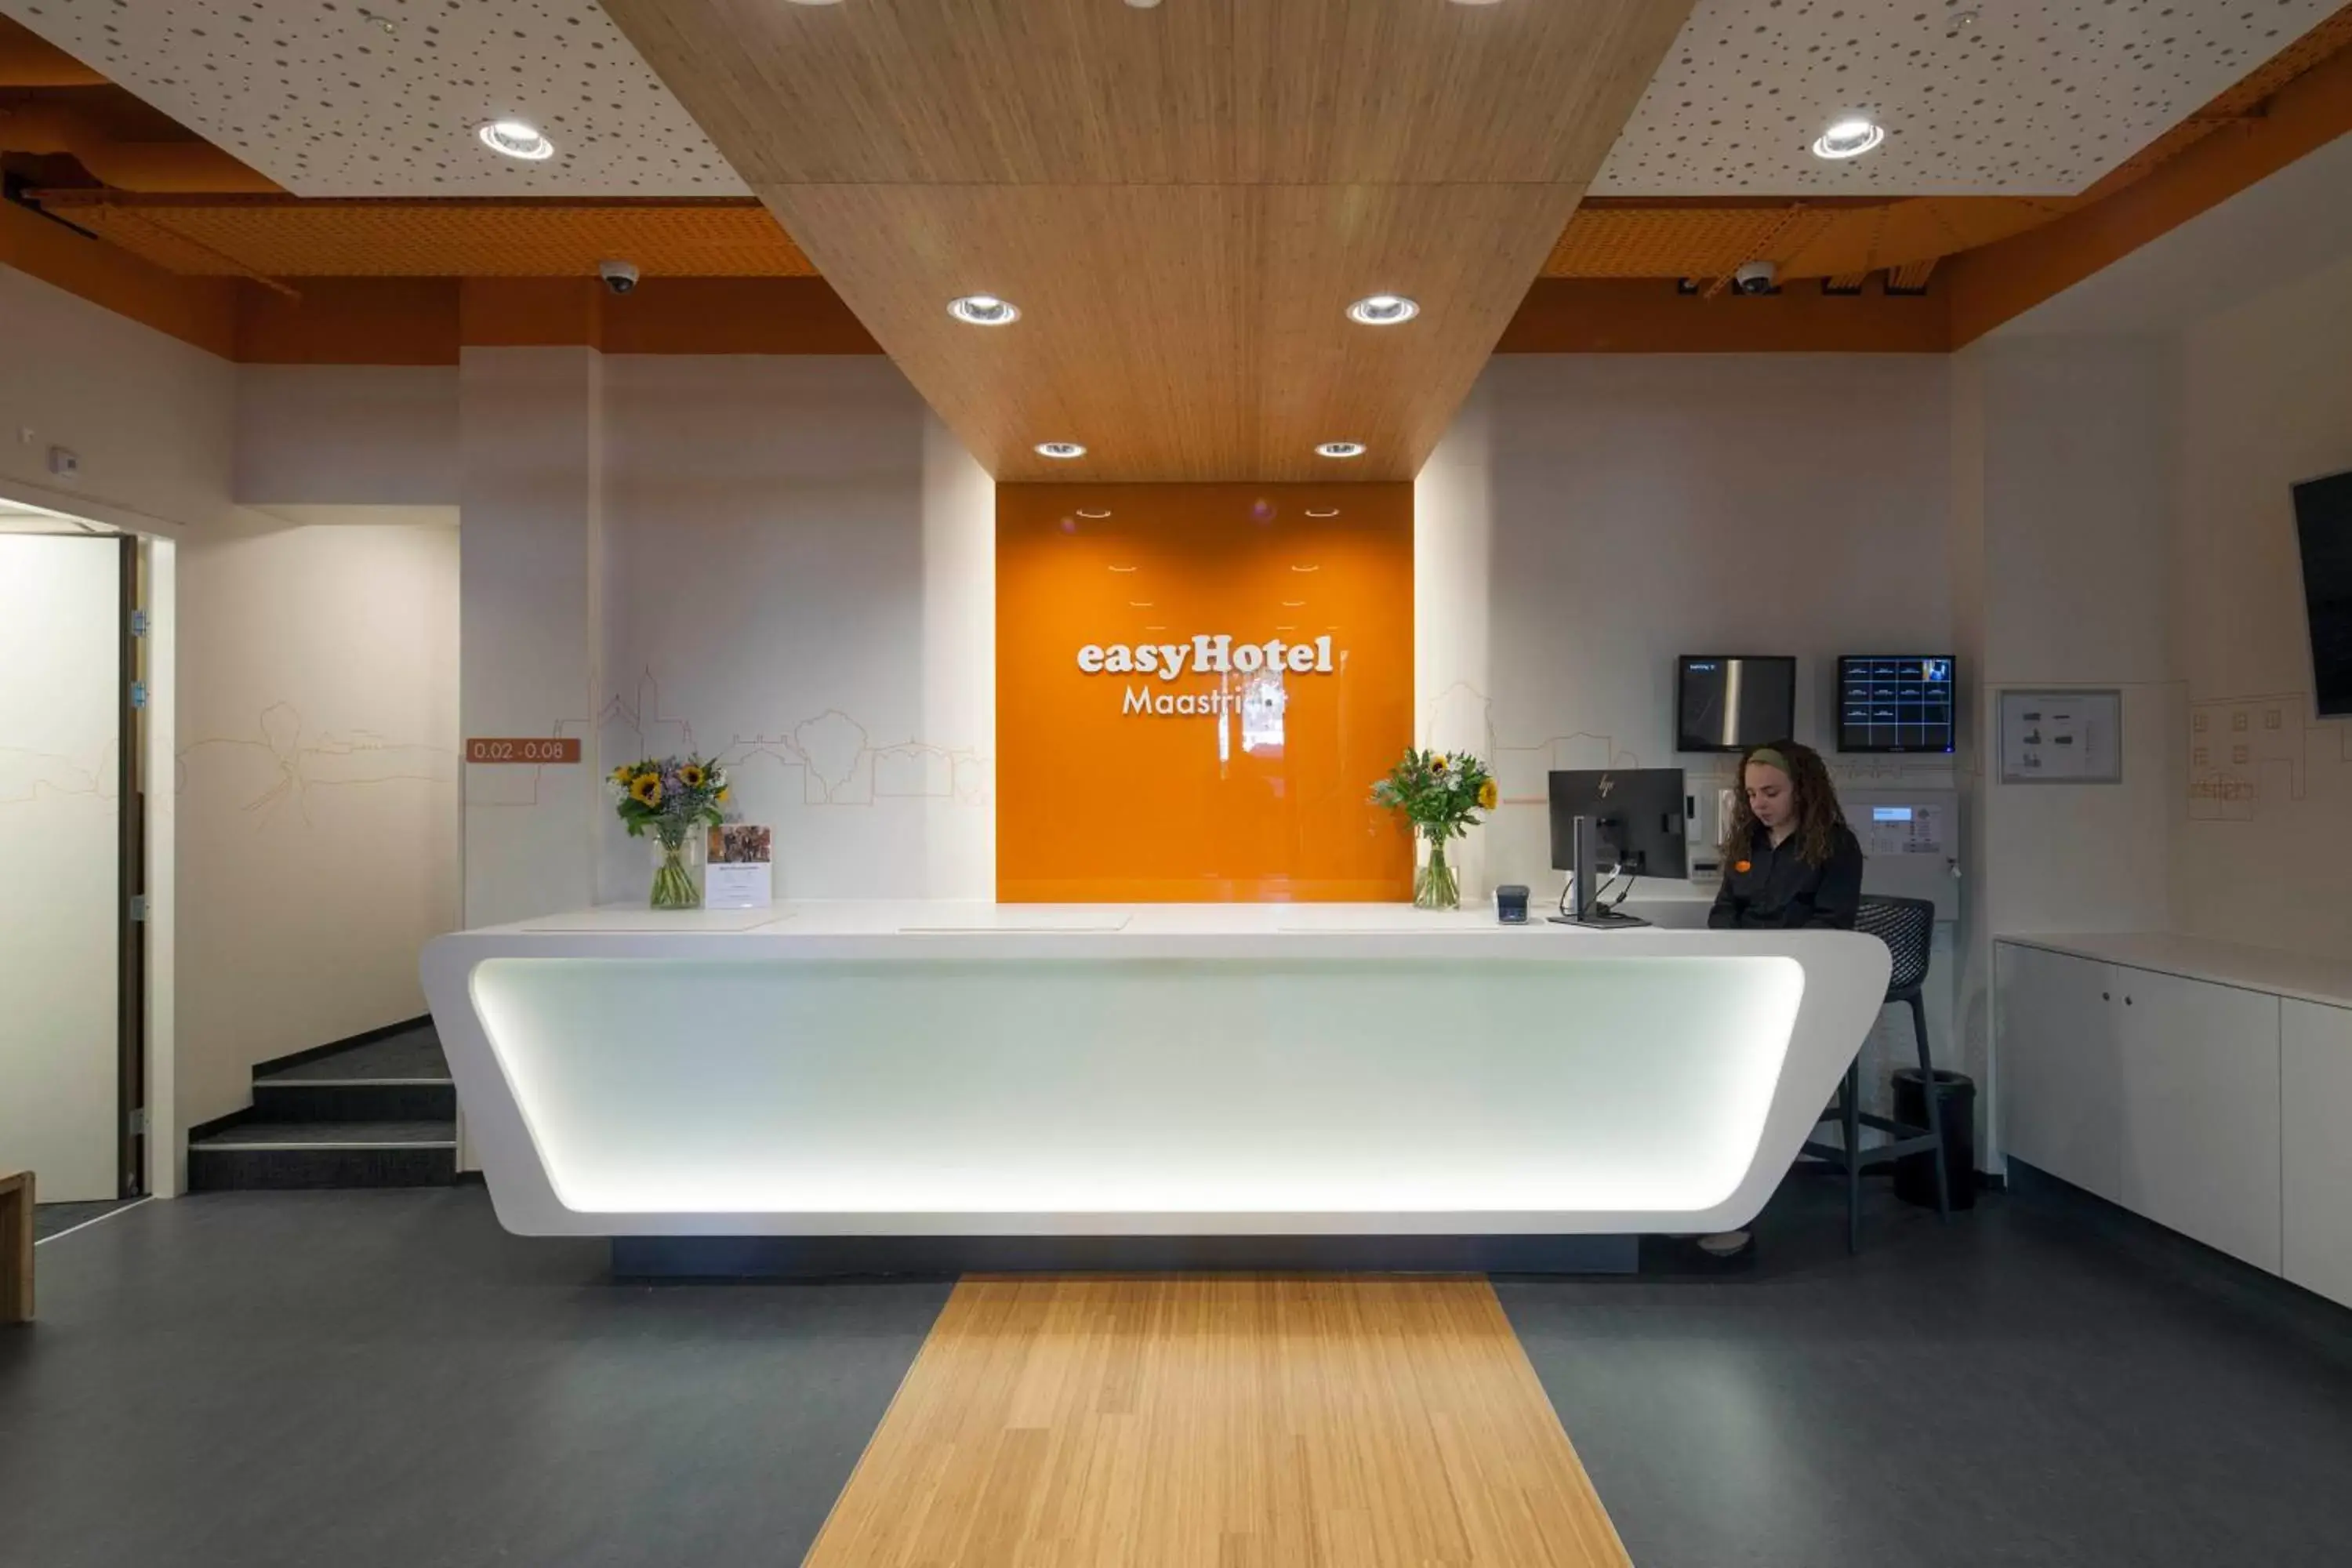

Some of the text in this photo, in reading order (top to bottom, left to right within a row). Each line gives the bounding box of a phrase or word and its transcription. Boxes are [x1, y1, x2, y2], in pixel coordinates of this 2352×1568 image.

[1076, 634, 1334, 681] easyHotel
[1122, 684, 1289, 715] Maastrit
[474, 742, 514, 759] 0.02
[524, 742, 564, 759] 0.08
